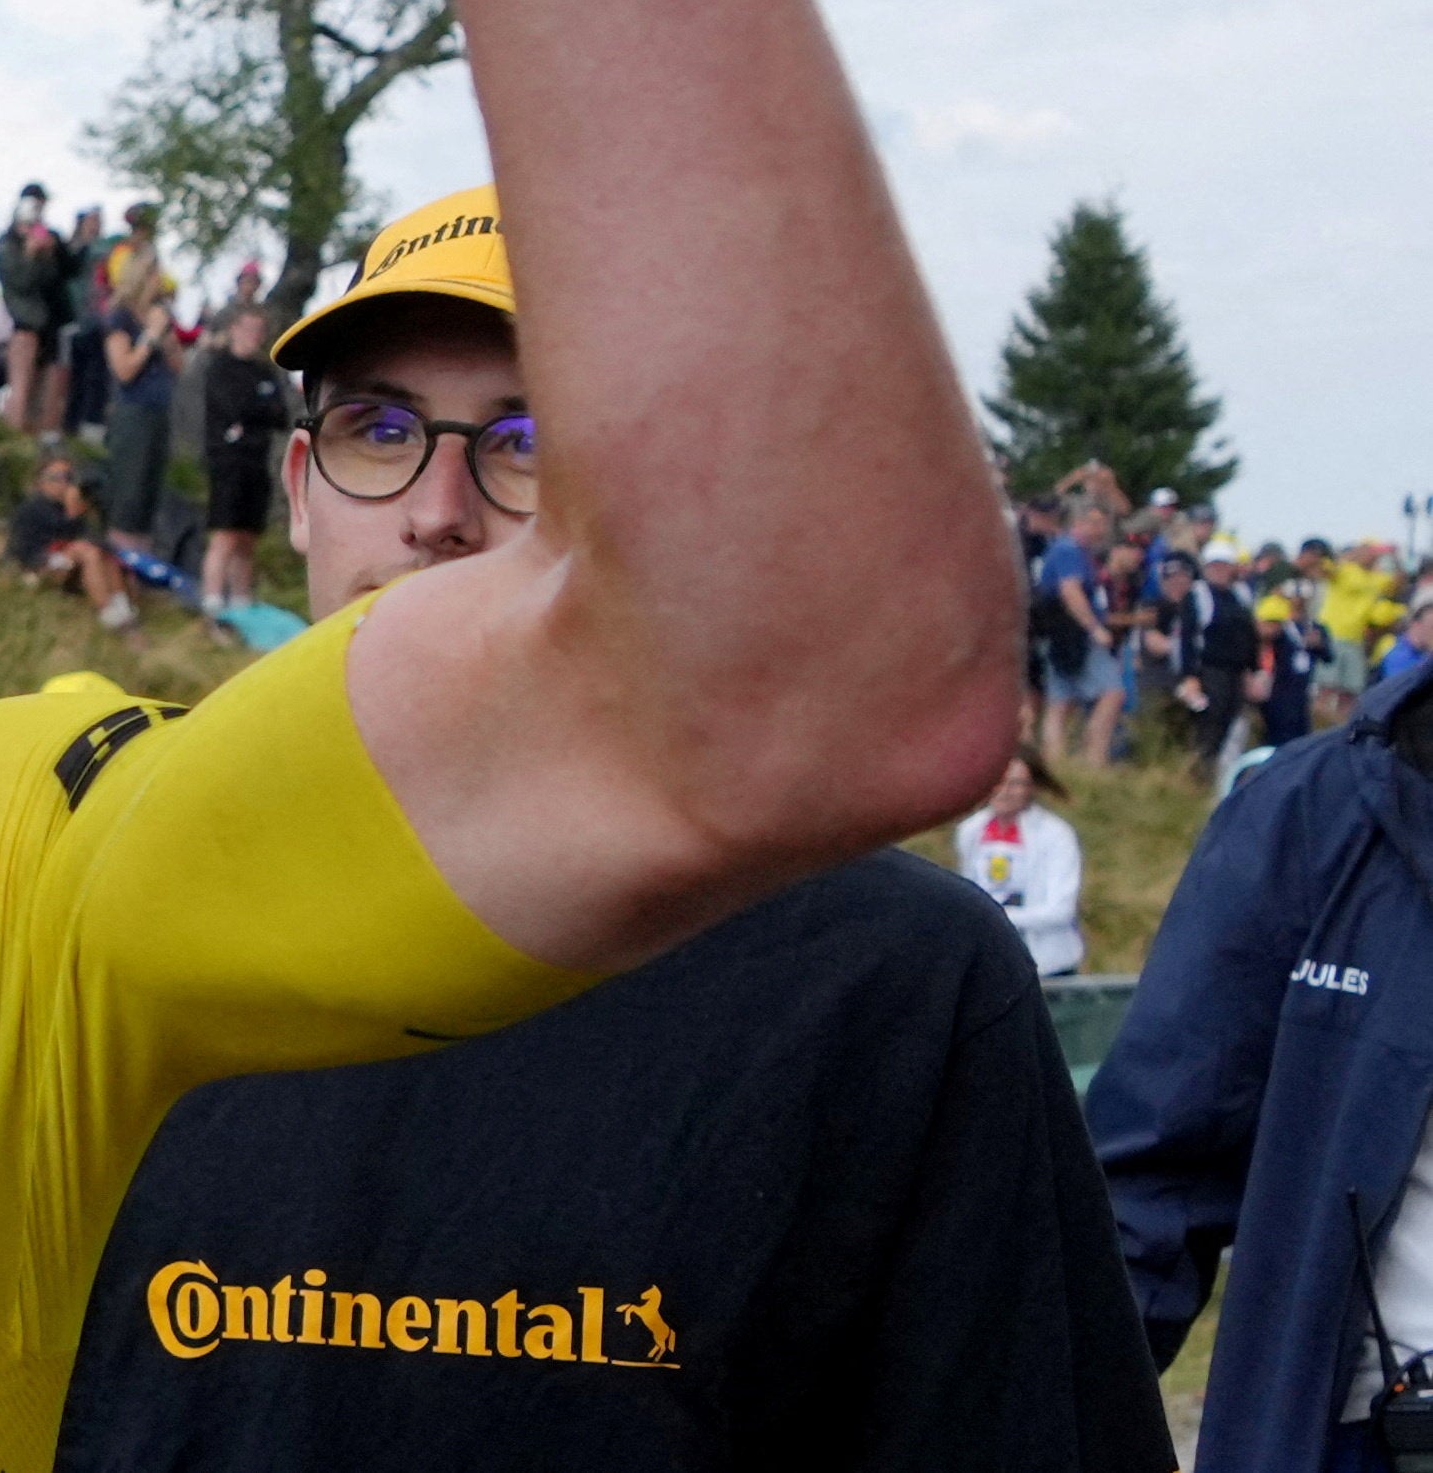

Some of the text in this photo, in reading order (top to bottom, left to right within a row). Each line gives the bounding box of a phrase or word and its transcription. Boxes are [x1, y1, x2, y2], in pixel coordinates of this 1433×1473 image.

[367, 215, 498, 281] Contin
[1291, 959, 1369, 996] JULES
[147, 1259, 609, 1364] Continental
